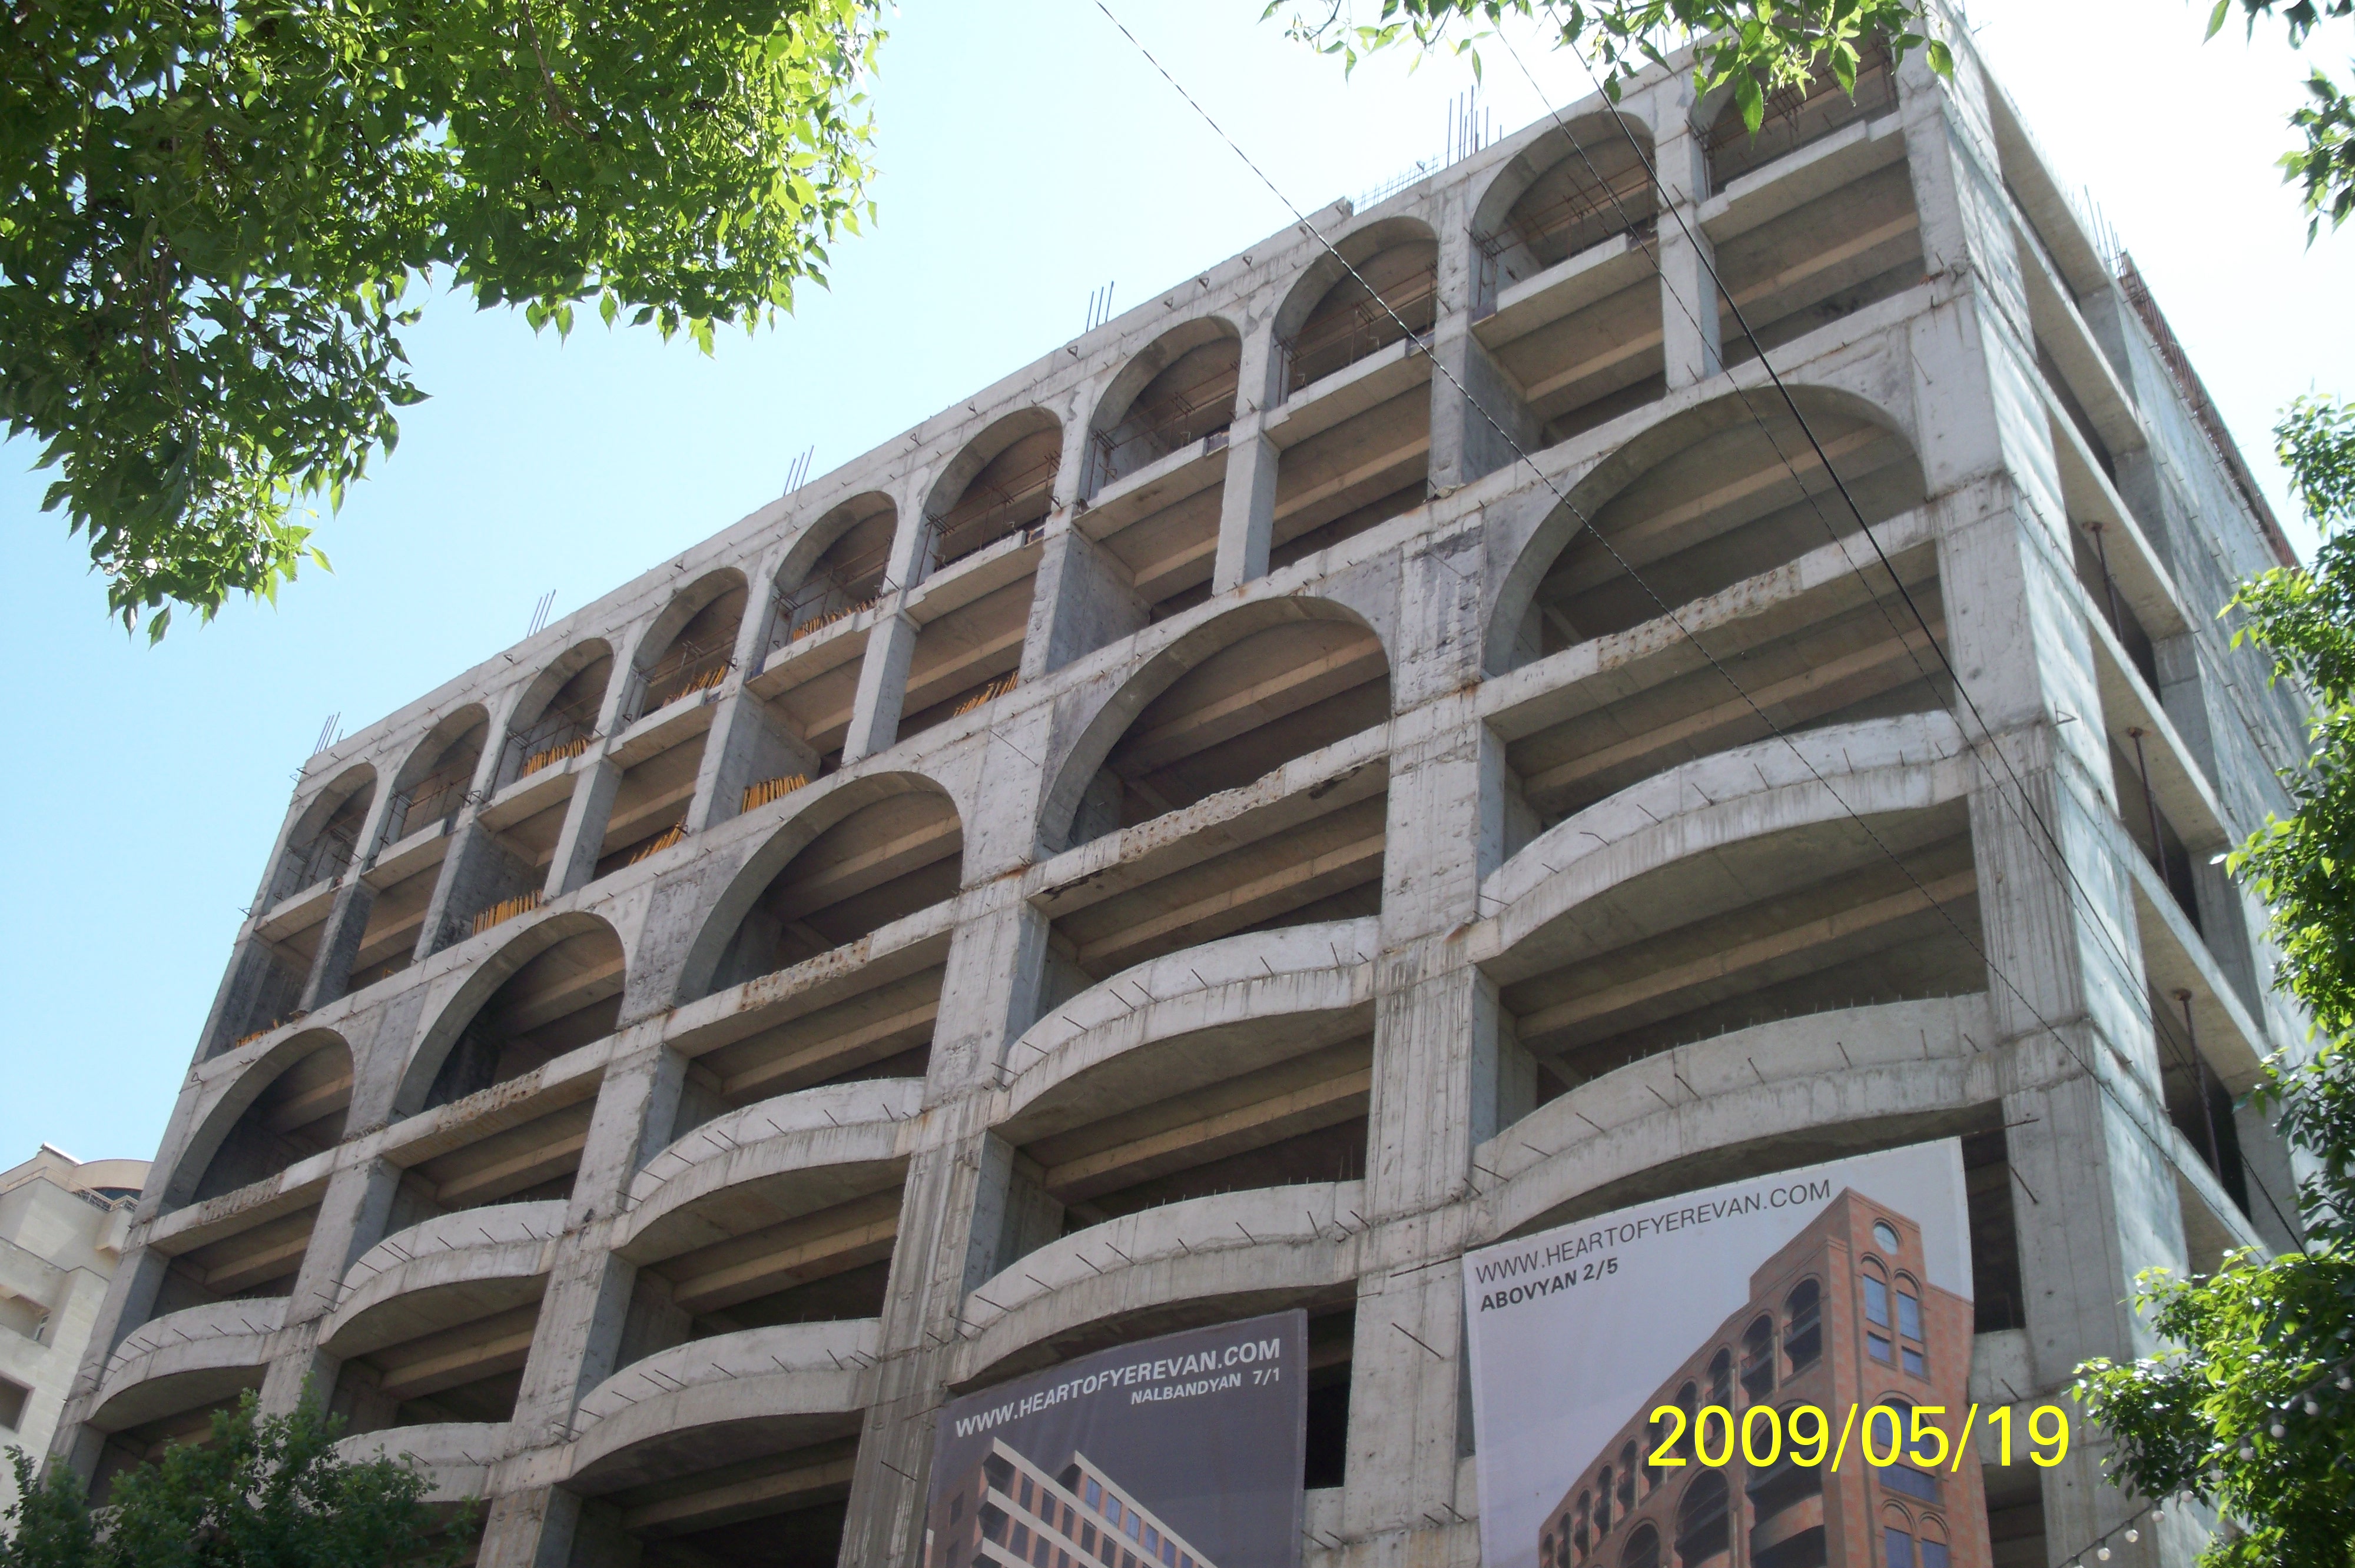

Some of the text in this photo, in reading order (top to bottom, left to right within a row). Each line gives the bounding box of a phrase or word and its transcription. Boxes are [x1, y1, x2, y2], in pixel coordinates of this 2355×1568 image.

[1475, 1179, 1830, 1284] WWW.HEARTOFYEREVAN.COM
[1480, 1257, 1618, 1313] ABOVYAN 2/5
[956, 1338, 1281, 1437] WWW.HEARTOFYEREVAN.COM
[1131, 1367, 1280, 1405] NALBANDYAN 7/1
